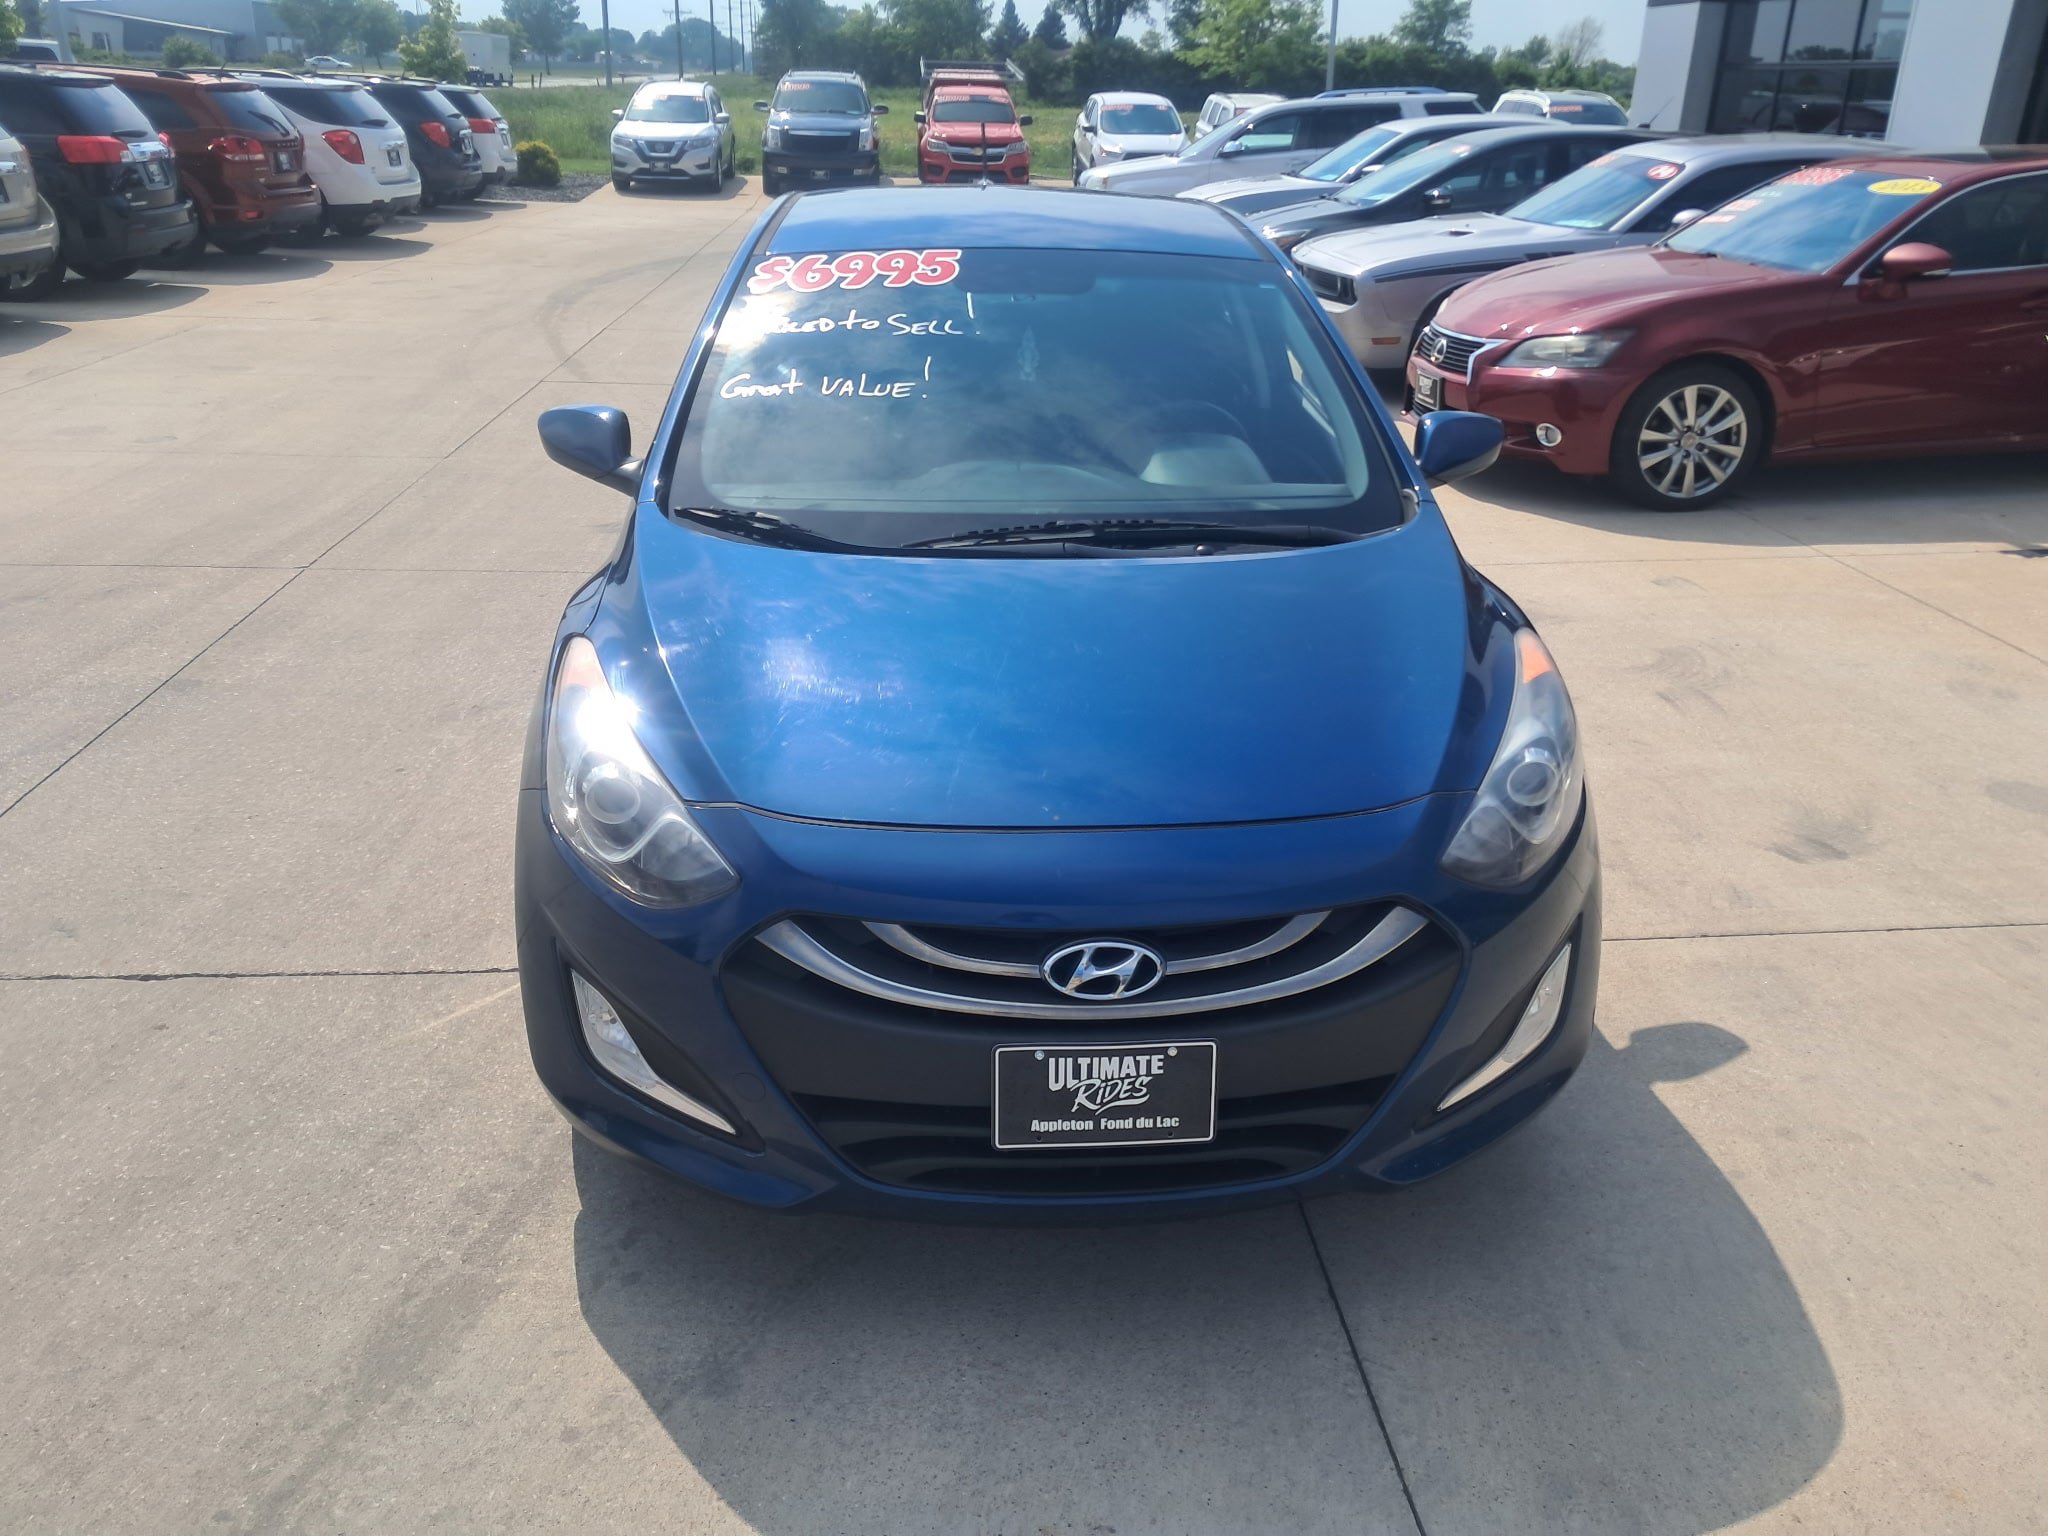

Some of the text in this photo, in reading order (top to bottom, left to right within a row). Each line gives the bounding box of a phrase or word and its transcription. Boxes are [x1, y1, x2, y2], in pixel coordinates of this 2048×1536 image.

[747, 249, 962, 294] $6995
[838, 309, 880, 330] to
[1049, 1054, 1164, 1092] ULTIMATE
[1031, 1116, 1180, 1132] Appleton Fond du Lac
